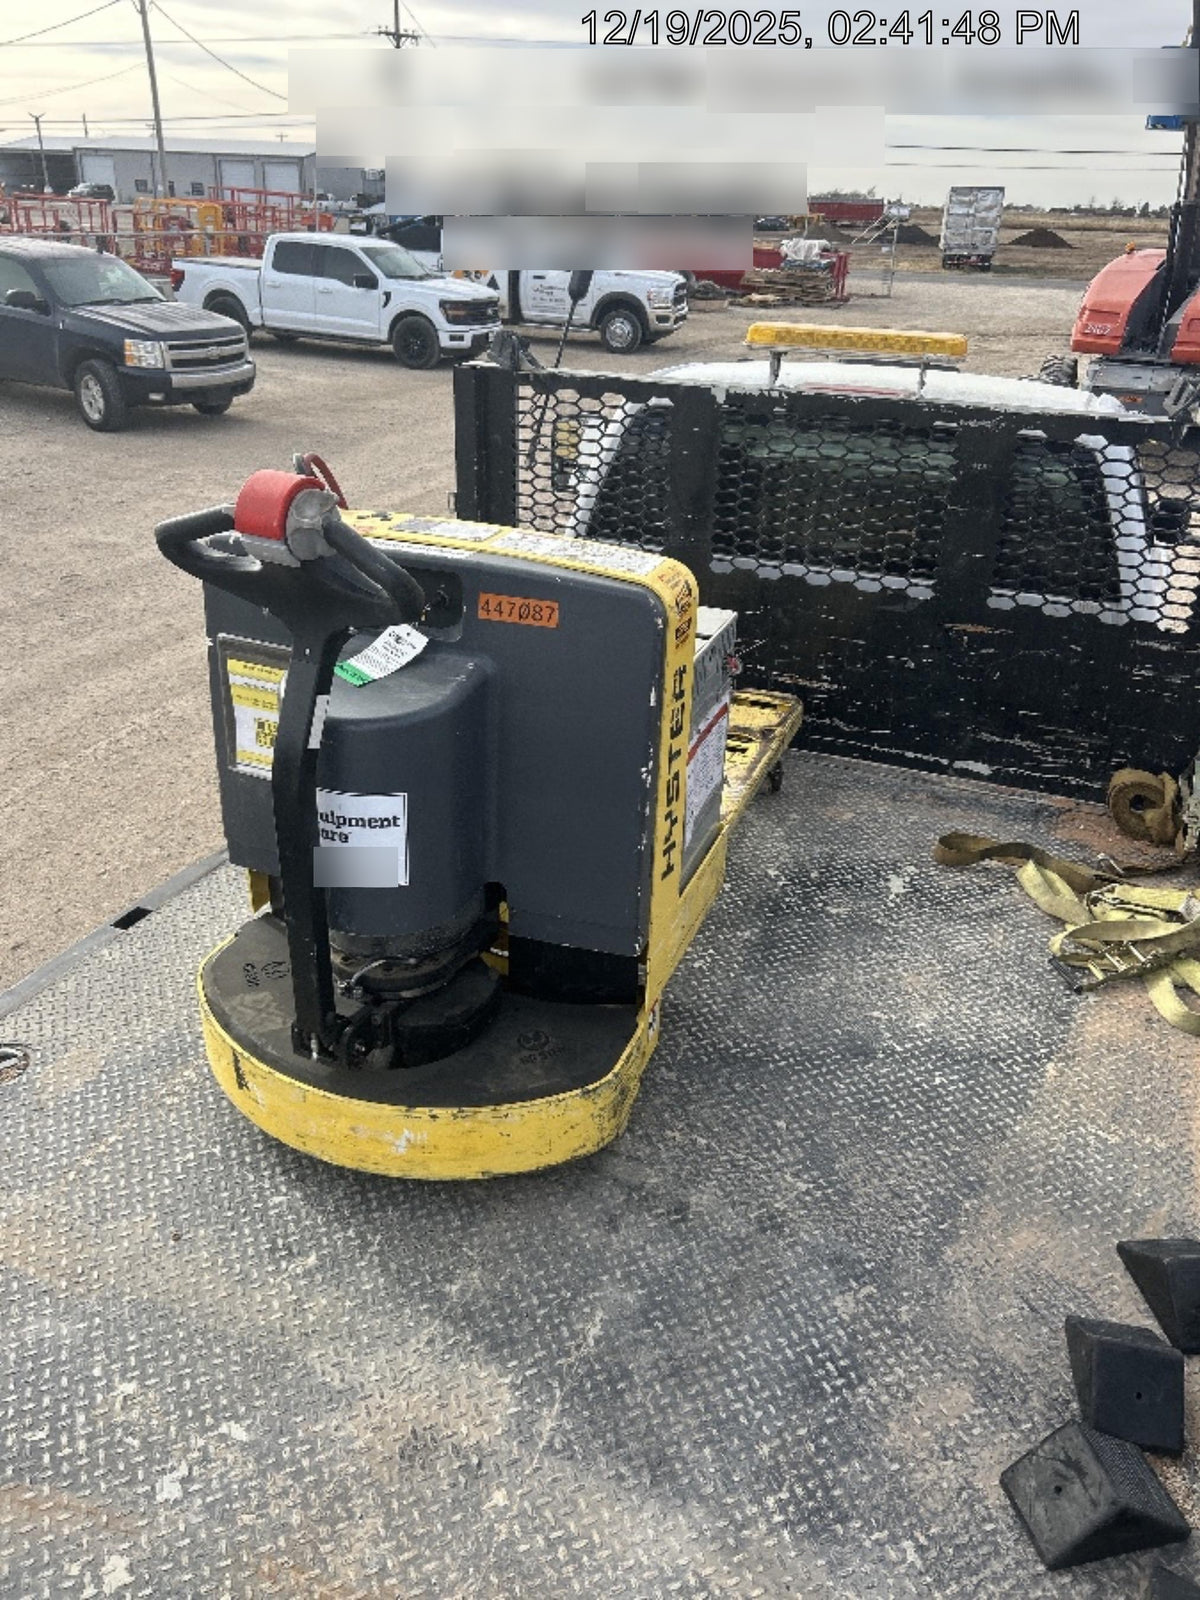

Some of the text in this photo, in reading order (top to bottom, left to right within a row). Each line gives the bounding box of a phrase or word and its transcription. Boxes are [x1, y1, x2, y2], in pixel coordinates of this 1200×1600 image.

[480, 598, 555, 623] 447087
[661, 664, 687, 881] HYSTER
[319, 809, 401, 829] uipment
[321, 828, 349, 843] are
